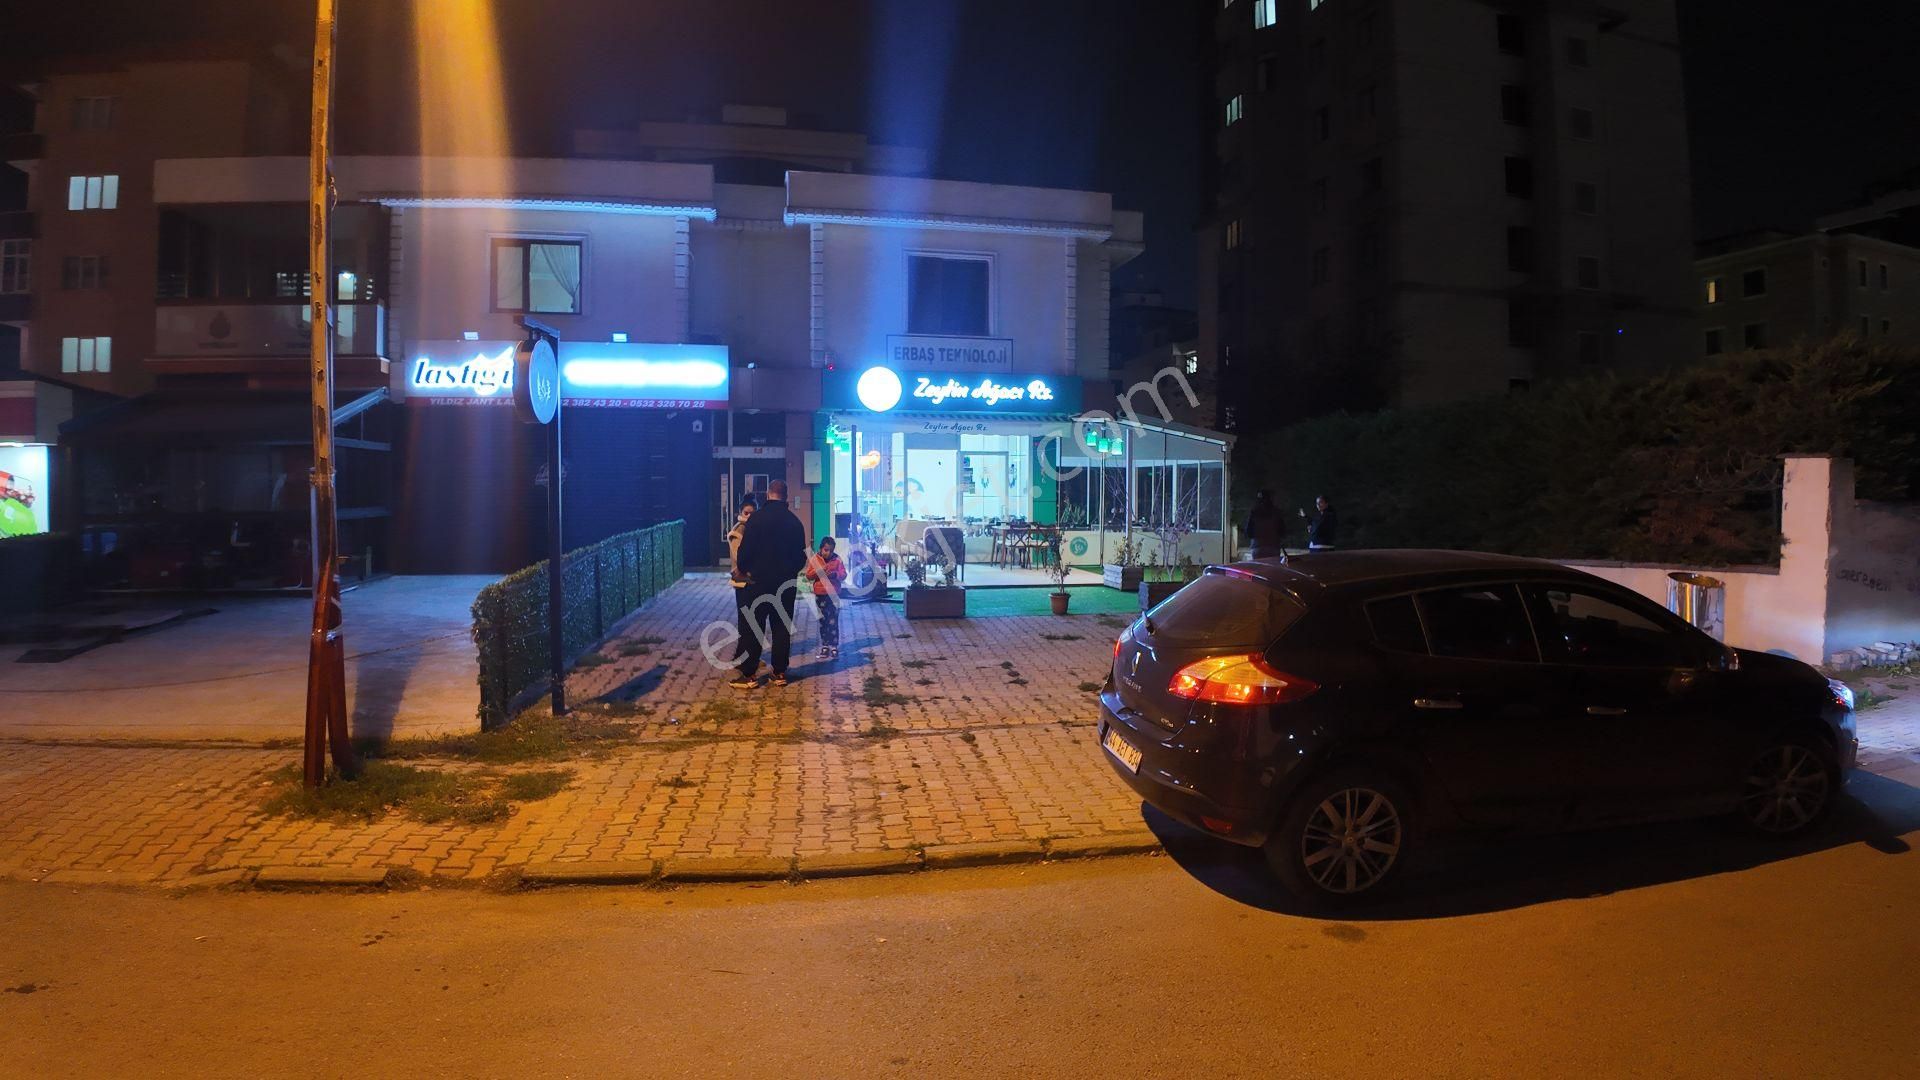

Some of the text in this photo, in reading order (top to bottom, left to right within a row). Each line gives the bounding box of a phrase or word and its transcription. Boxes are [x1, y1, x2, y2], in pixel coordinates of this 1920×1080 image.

[894, 346, 1008, 365] ERBAŞ TEKNOLOJİ
[913, 377, 969, 405] Zeytin
[971, 379, 1025, 406] Ağacı
[430, 398, 465, 406] YILDIZ
[466, 398, 493, 406] JANT
[923, 421, 949, 432] Zeytin
